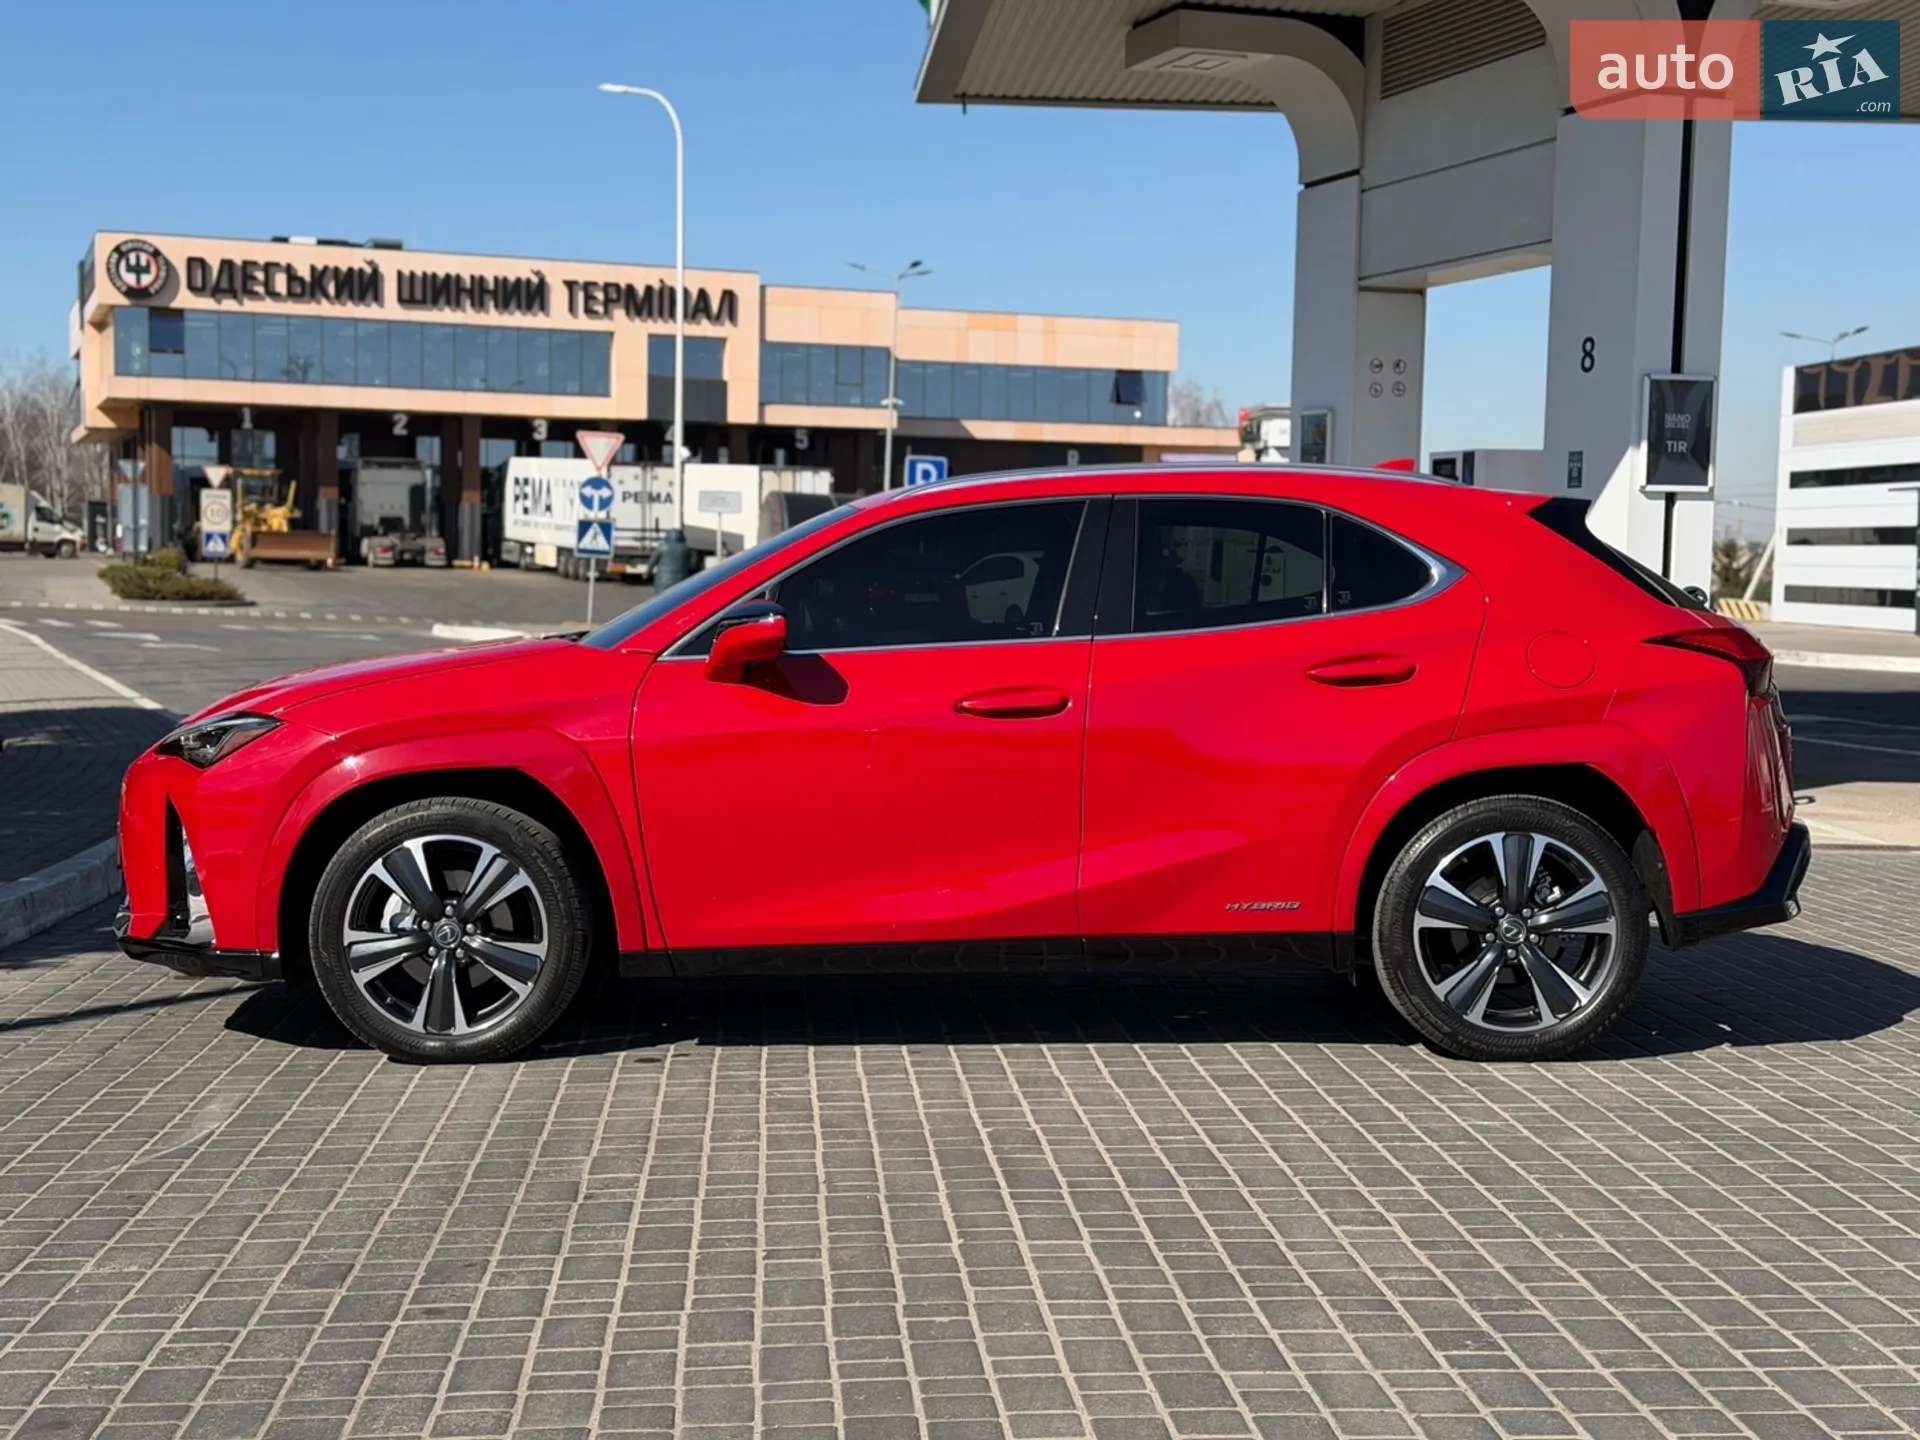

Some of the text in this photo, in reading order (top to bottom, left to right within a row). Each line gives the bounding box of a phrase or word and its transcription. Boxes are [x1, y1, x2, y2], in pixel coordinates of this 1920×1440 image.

[187, 256, 381, 304] ОДЕСЬКИЙ
[397, 268, 546, 313] ШИННИЙ
[562, 278, 735, 324] ТЕРМІНАЛ
[1580, 336, 1596, 373] 8
[241, 407, 253, 429] 1
[392, 413, 408, 436] 2
[1664, 412, 1691, 422] NANO
[532, 419, 548, 440] 3
[795, 429, 809, 449] 5
[1666, 440, 1688, 453] TIR
[513, 475, 553, 518] PEMA
[621, 489, 674, 505] PEMA
[1225, 901, 1302, 912] HYBRID
